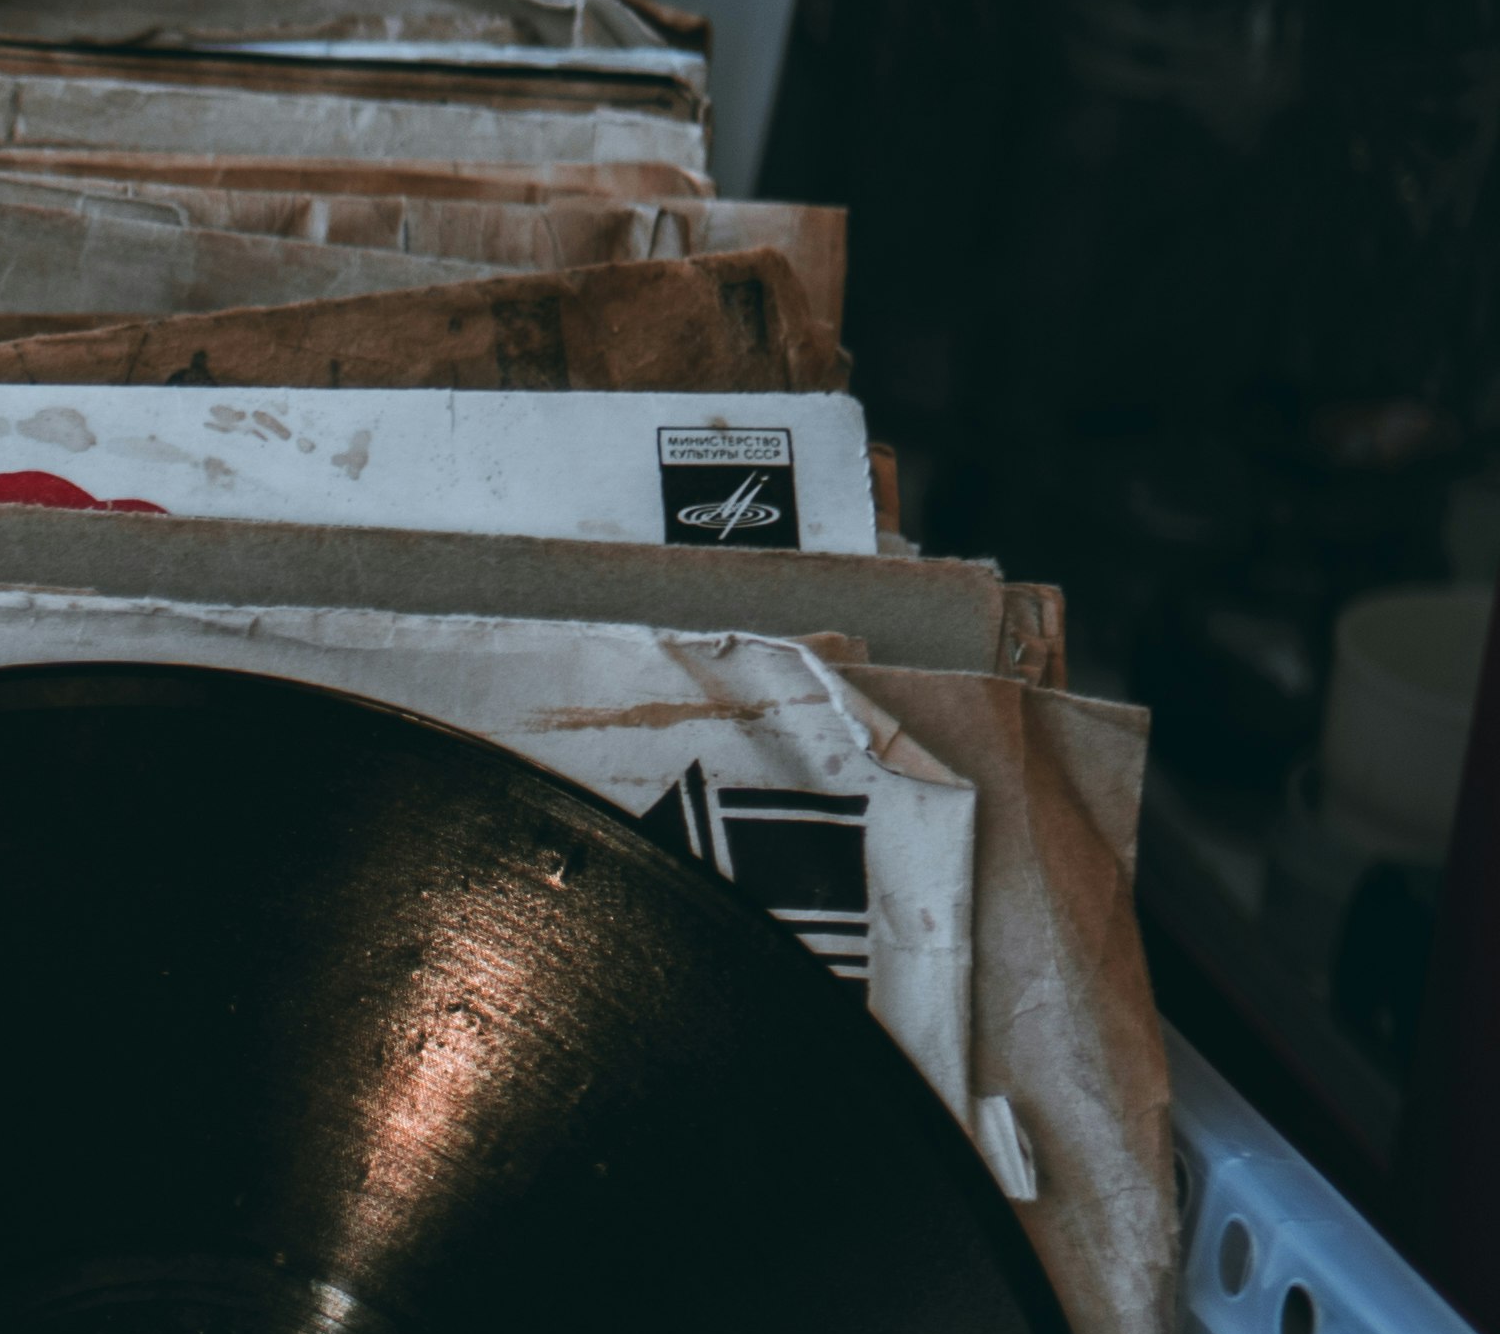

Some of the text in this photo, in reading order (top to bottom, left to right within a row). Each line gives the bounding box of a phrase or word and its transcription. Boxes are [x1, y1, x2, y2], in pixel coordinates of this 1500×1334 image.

[667, 435, 781, 448] МИНИСТЕРСТВО
[669, 448, 782, 460] КУЛЬТУРЫ СССР
